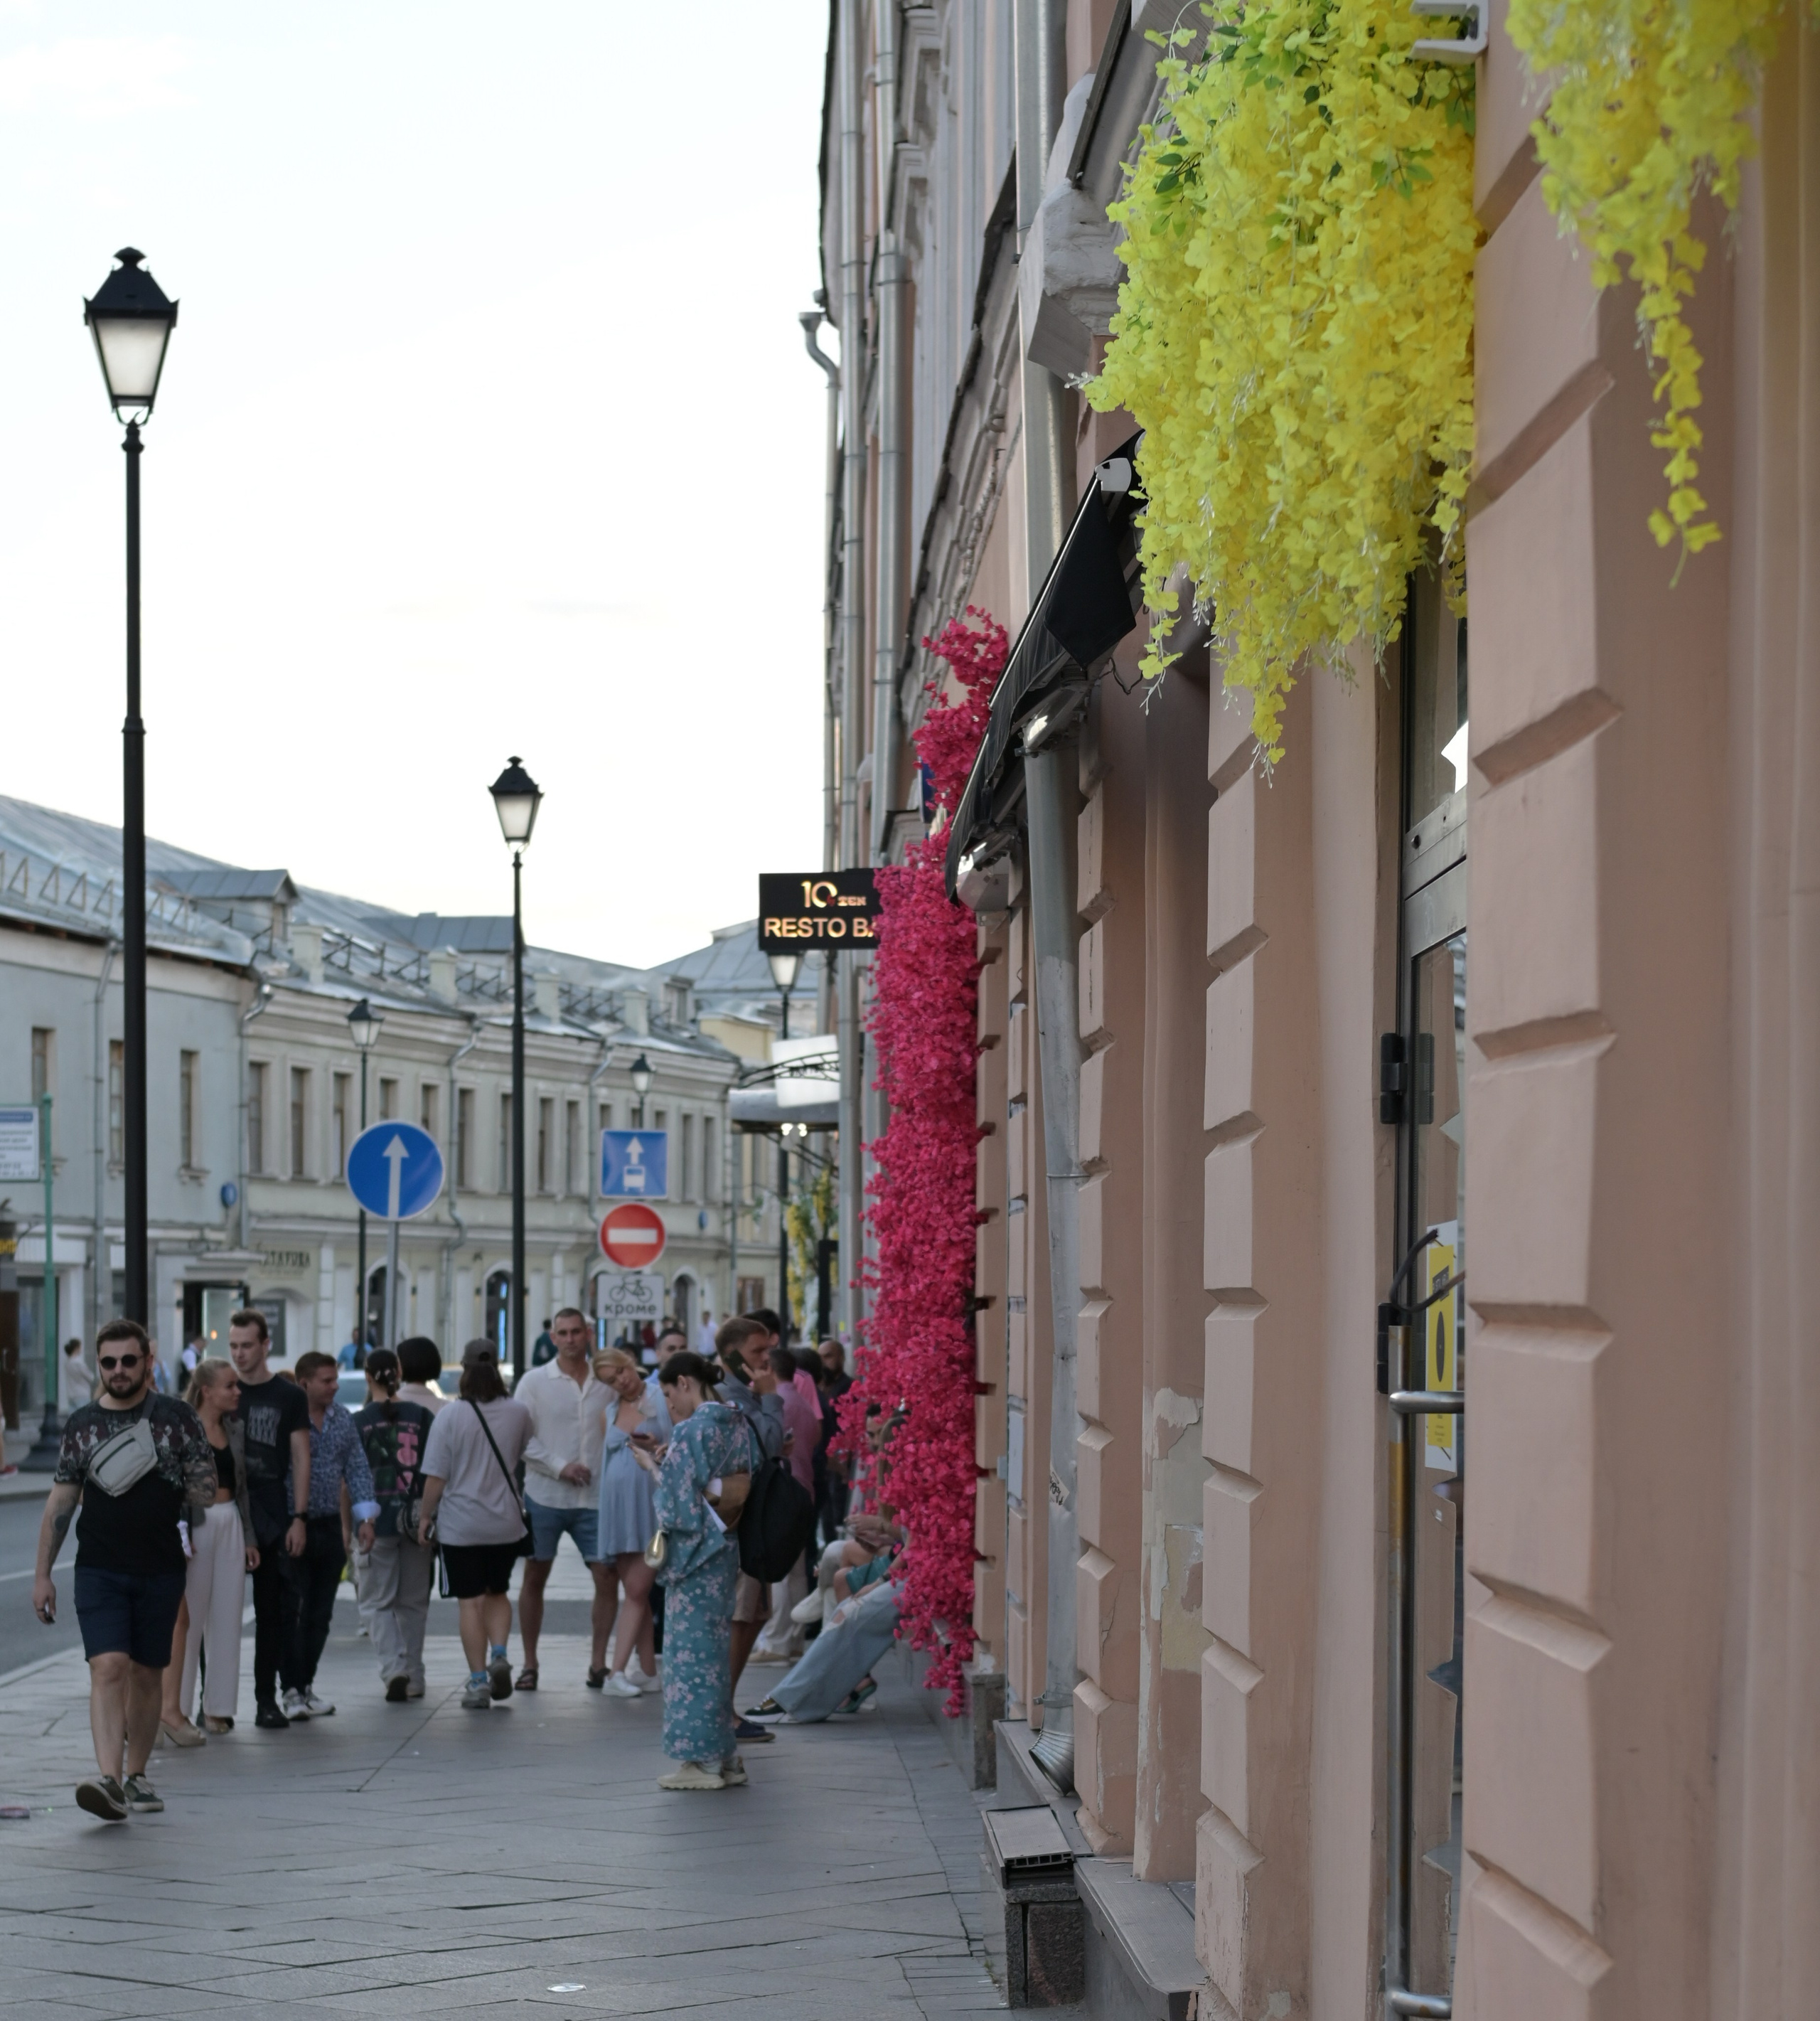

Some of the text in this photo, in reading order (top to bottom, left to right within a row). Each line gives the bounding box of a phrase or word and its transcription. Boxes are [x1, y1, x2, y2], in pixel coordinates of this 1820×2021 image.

[801, 880, 867, 908] 10 TEN
[764, 917, 847, 938] RESTO
[604, 1303, 657, 1317] кроме
